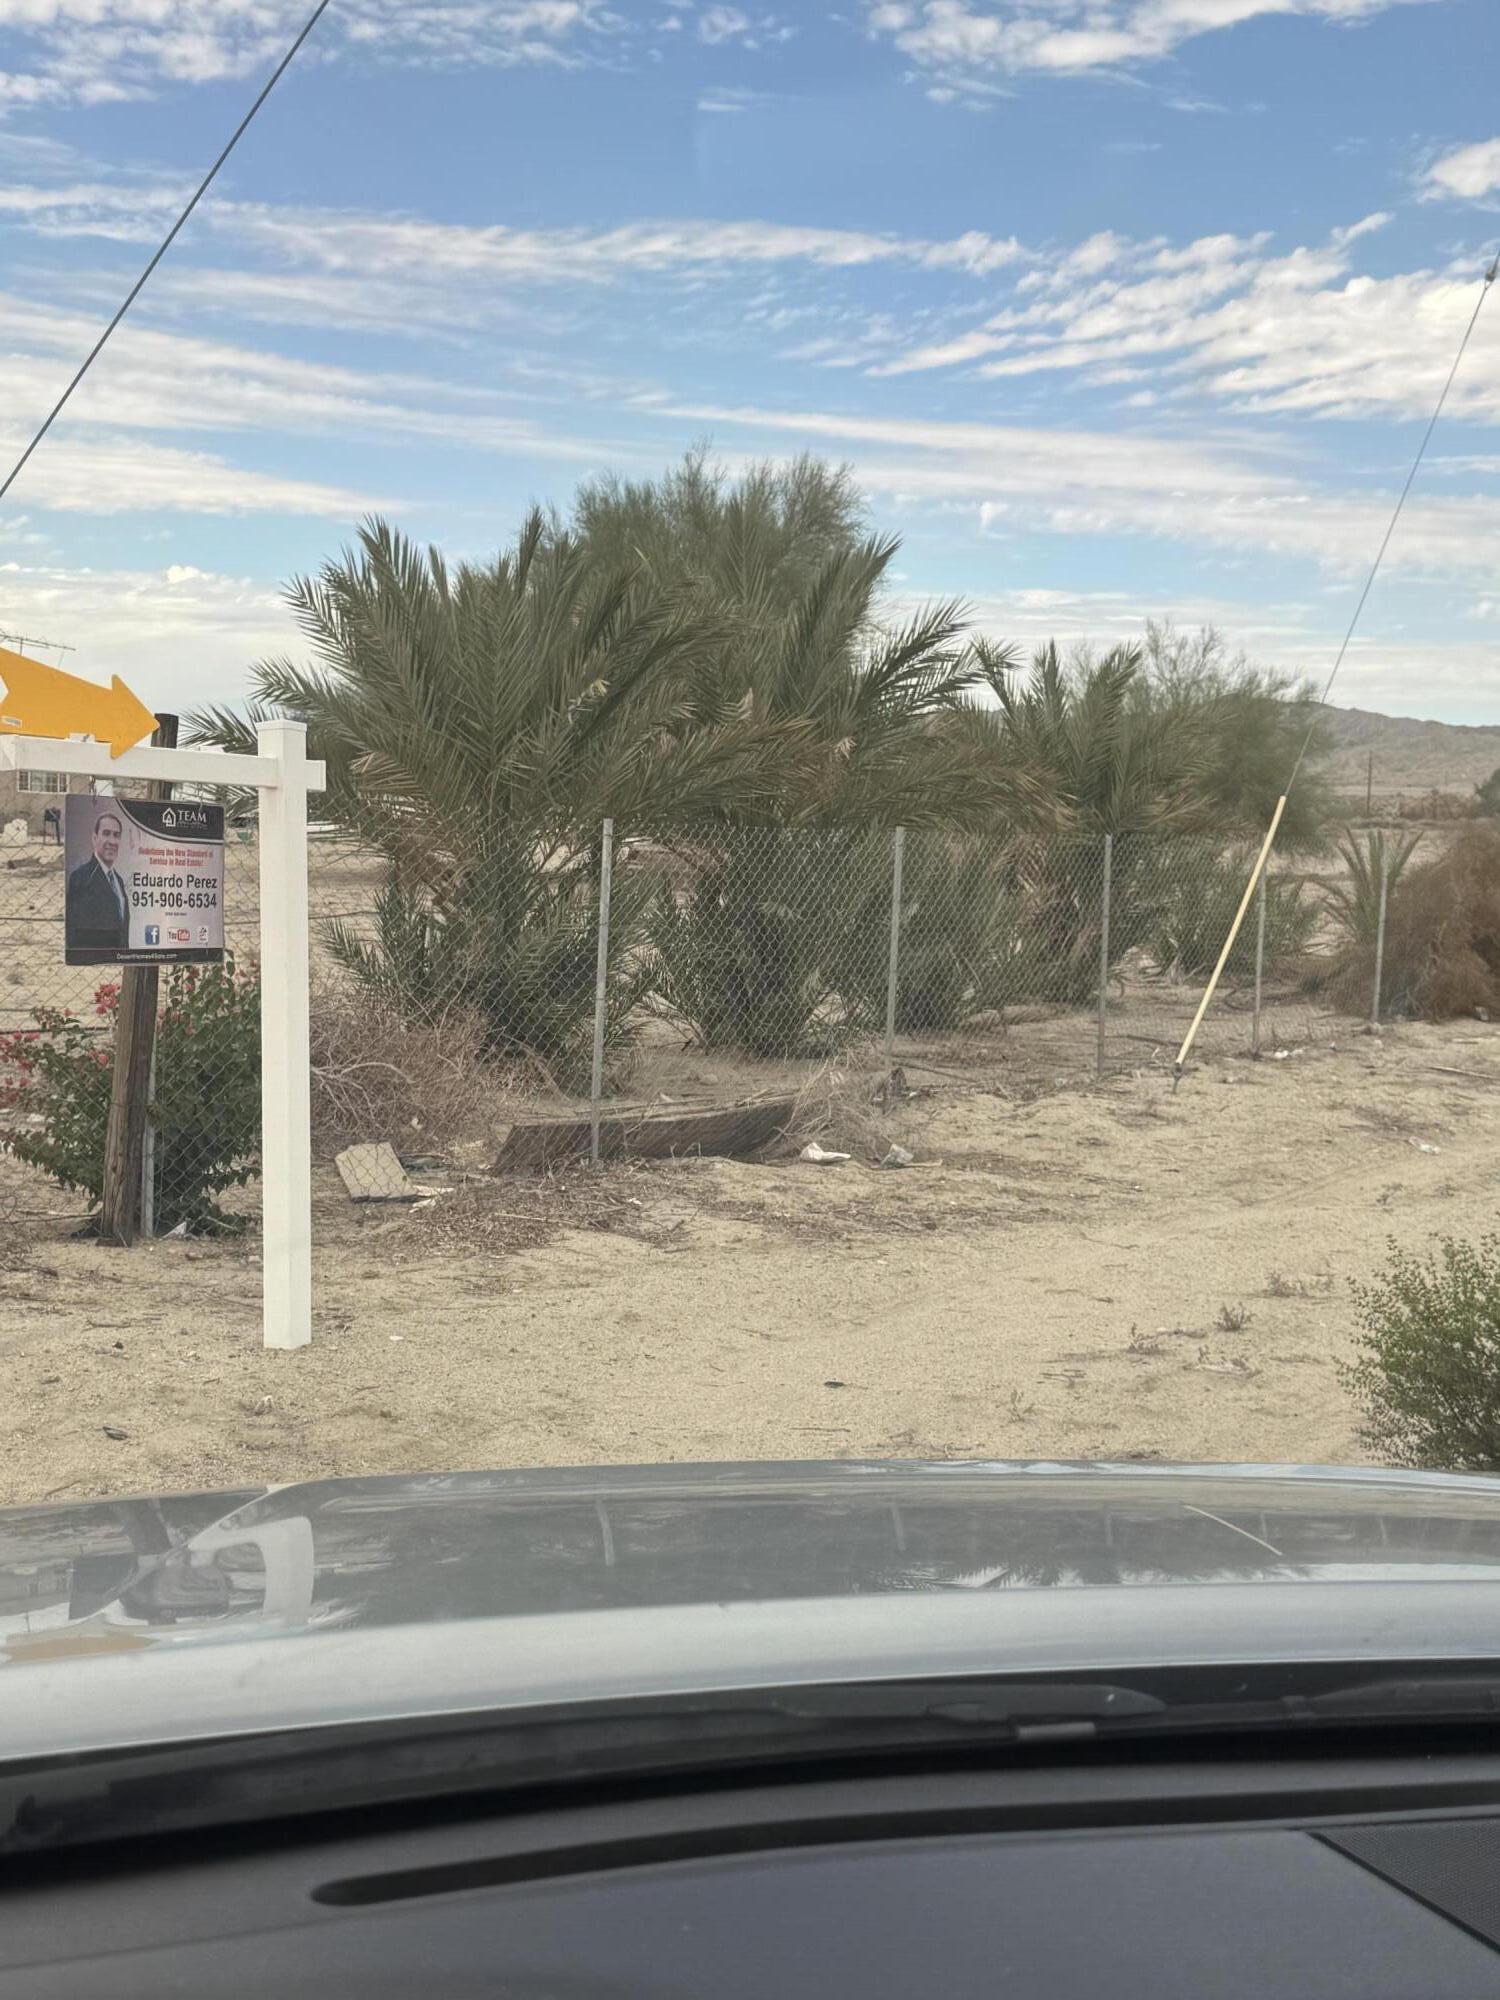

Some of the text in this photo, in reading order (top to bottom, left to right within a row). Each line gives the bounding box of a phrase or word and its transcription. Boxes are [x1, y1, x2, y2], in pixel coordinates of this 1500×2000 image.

[177, 810, 207, 823] TEAM
[133, 872, 218, 890] Eduardo Perez
[132, 891, 217, 908] 951-906-6534
